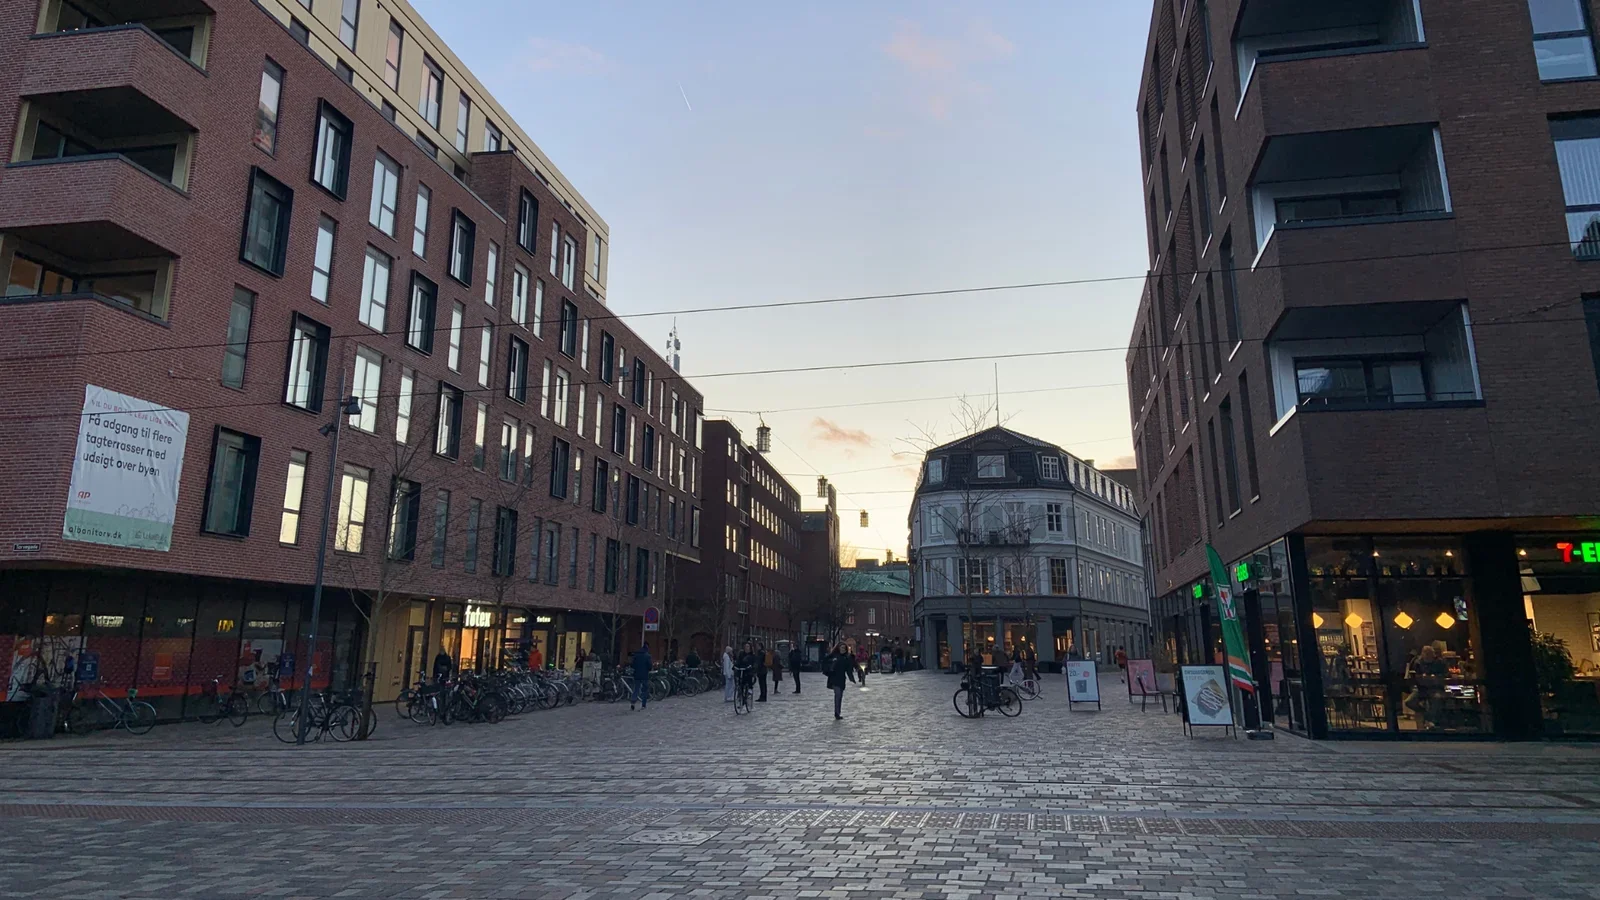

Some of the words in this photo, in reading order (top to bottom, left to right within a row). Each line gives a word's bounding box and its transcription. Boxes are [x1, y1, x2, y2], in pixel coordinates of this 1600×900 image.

[103, 402, 112, 410] DU
[88, 413, 101, 426] Få
[103, 419, 139, 439] adgang
[141, 427, 151, 439] til
[152, 429, 173, 444] flere
[86, 431, 145, 455] tagterrasser
[146, 449, 167, 460] med
[82, 451, 115, 469] udsigt
[116, 460, 137, 472] over
[138, 461, 160, 477] byen
